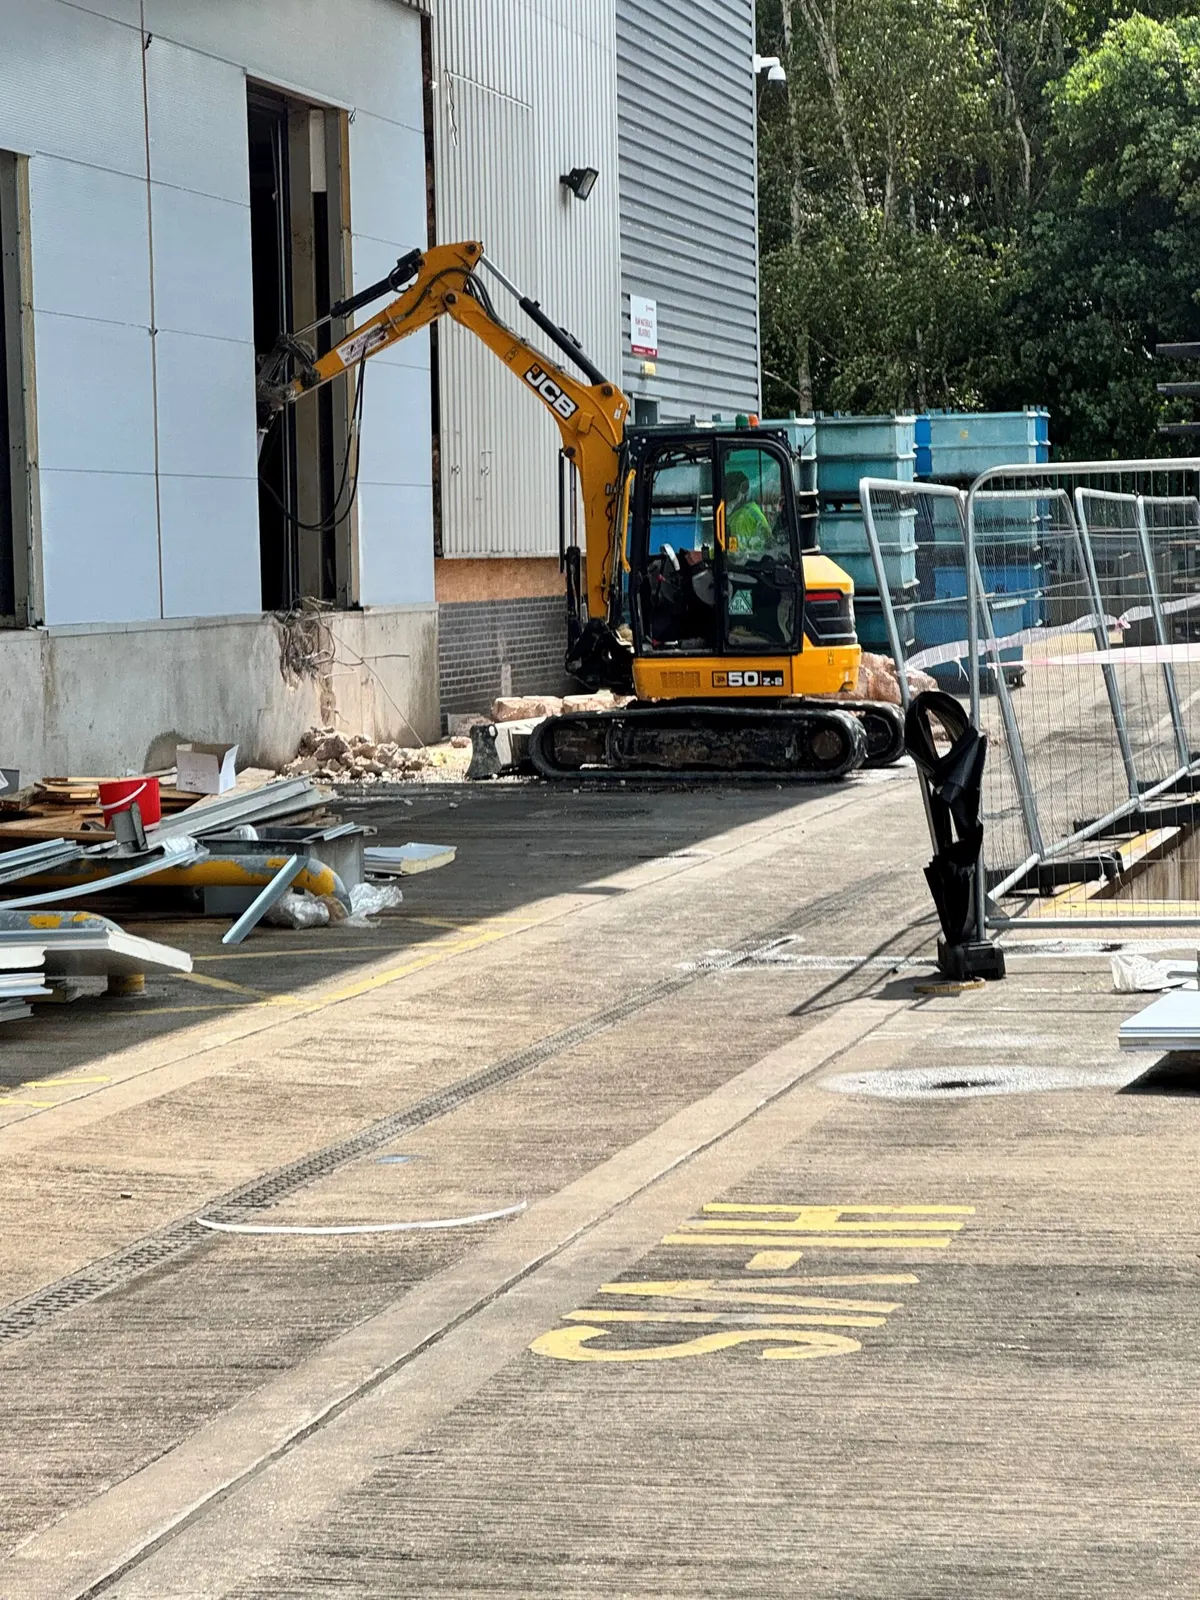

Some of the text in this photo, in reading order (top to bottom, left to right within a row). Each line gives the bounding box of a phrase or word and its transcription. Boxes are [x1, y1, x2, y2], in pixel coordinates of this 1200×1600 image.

[525, 370, 577, 418] JCB
[728, 671, 759, 687] 50
[528, 1202, 976, 1363] HI-VIS
